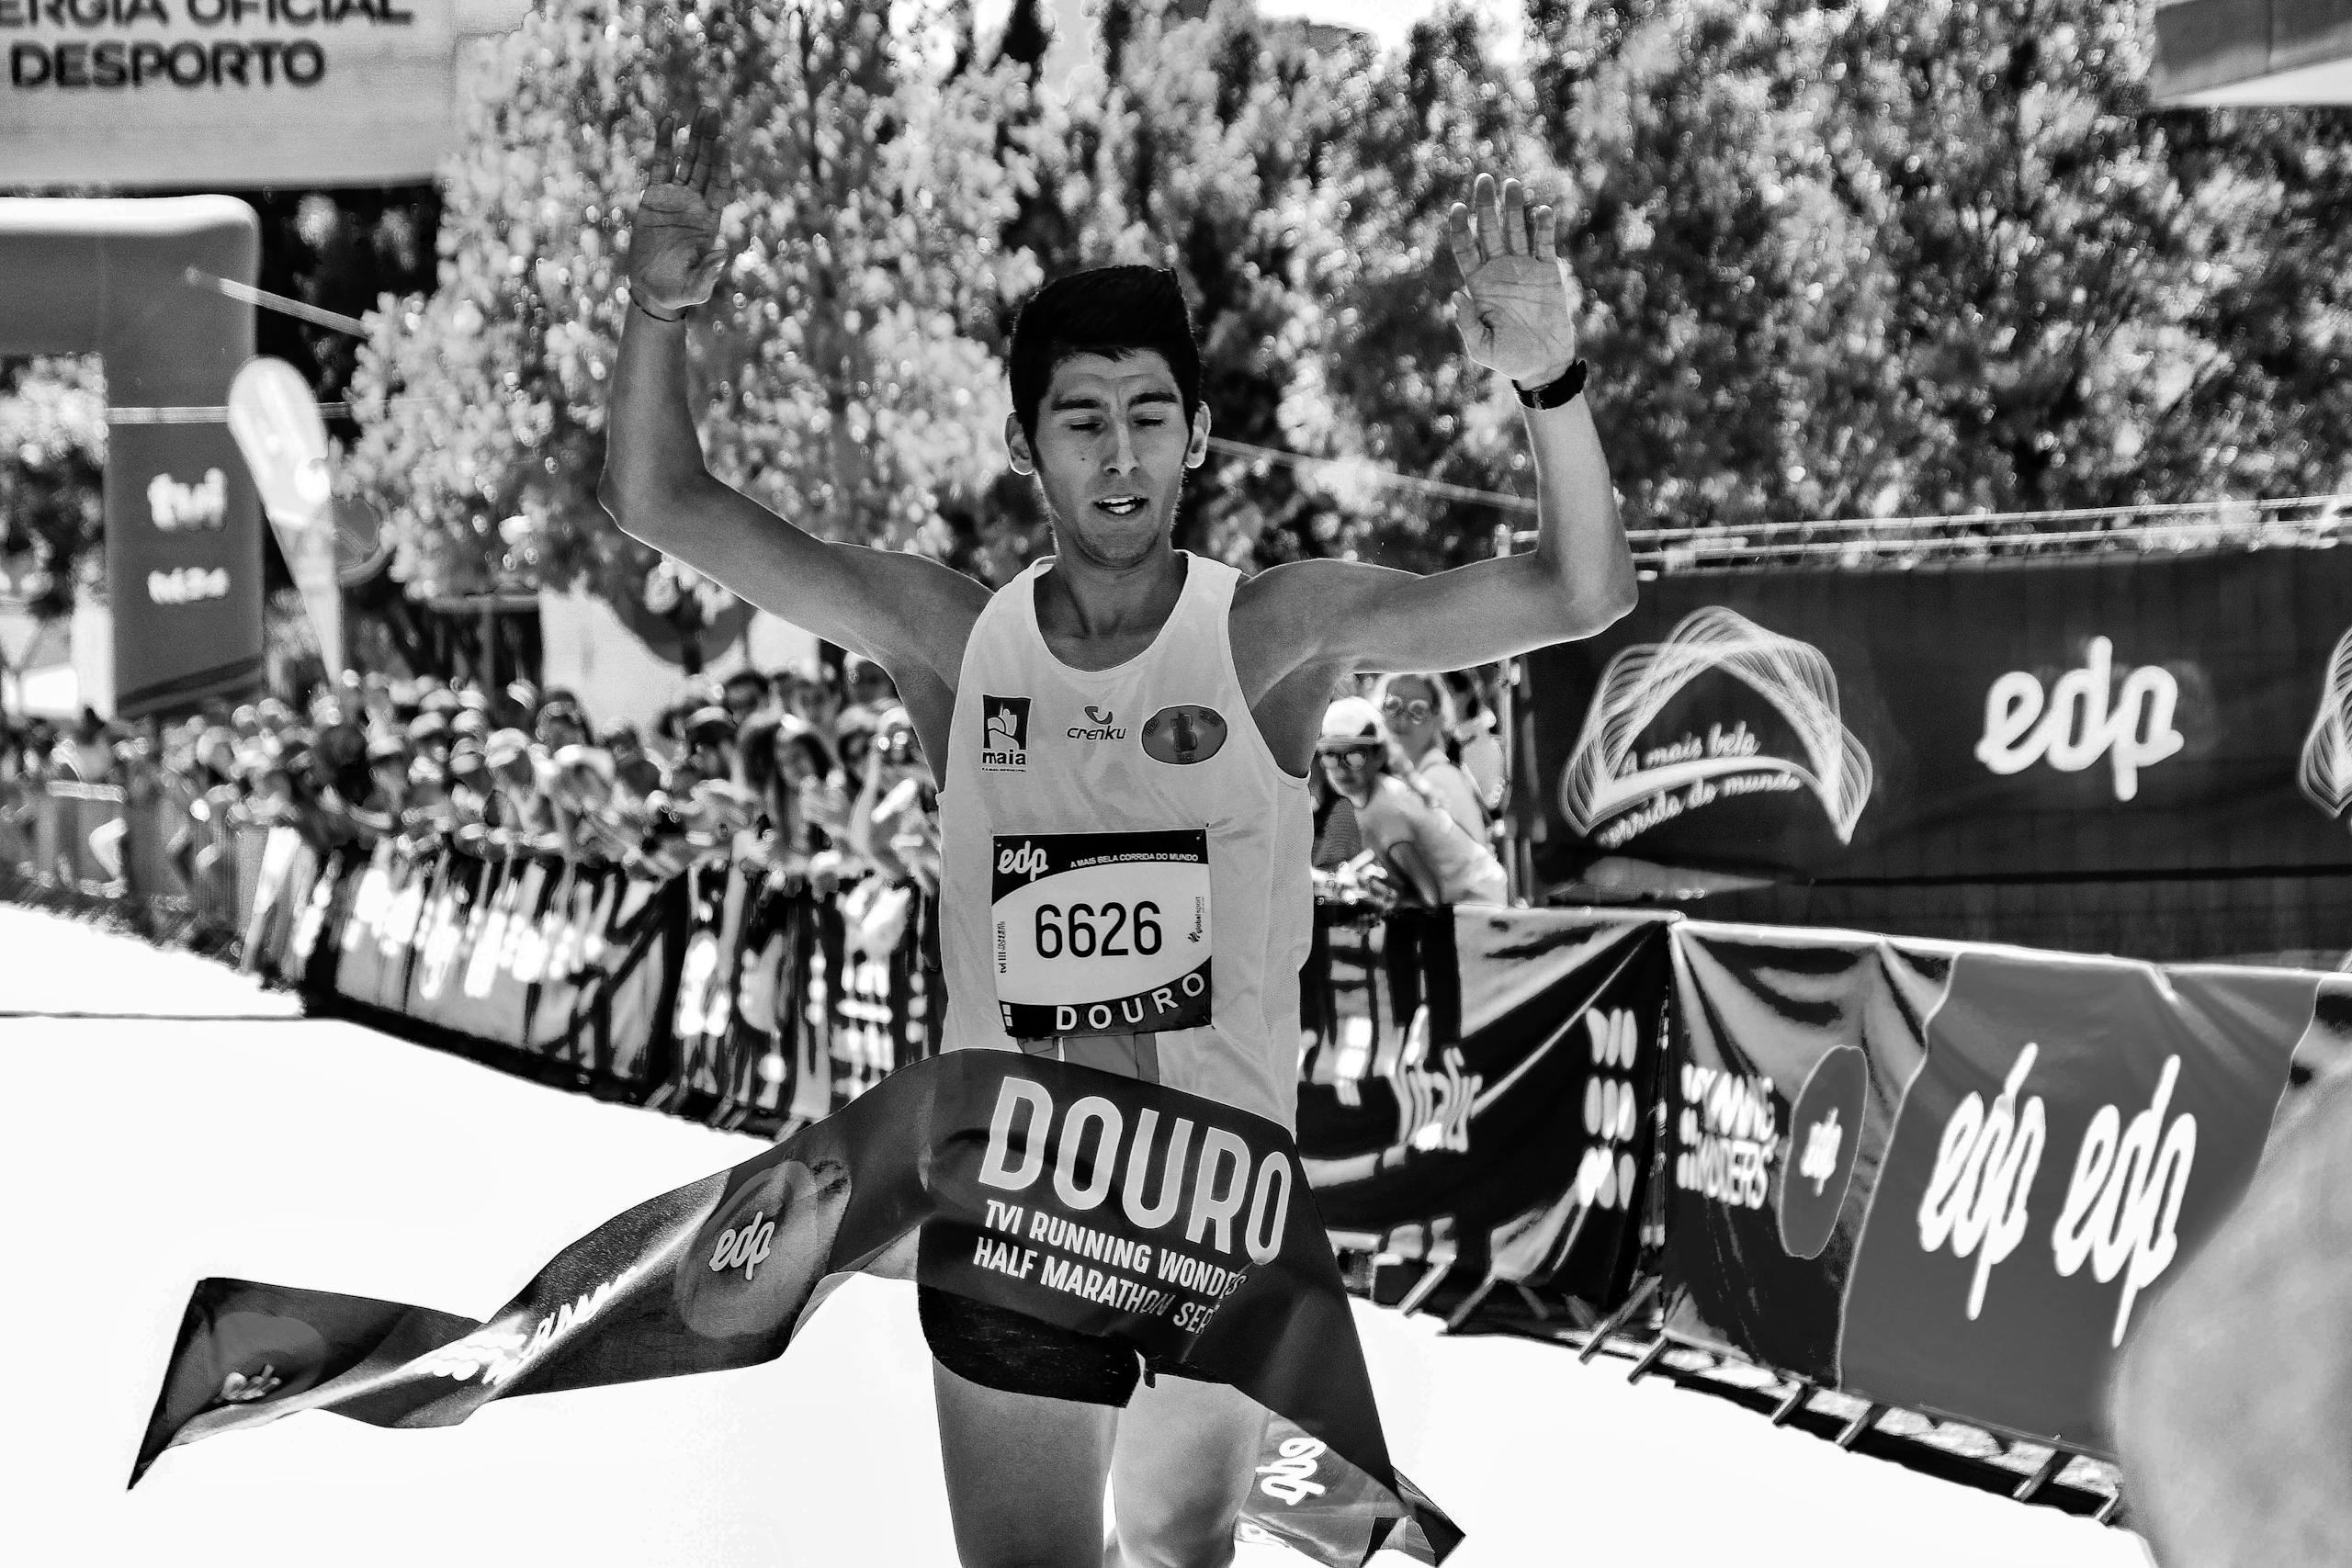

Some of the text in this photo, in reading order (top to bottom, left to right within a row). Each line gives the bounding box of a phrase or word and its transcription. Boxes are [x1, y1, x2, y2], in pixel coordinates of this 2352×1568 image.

[10, 39, 327, 88] DESPORTO
[1067, 725, 1127, 740] crenku
[1643, 731, 1703, 768] mais
[1707, 720, 1762, 757] bela
[1974, 635, 2185, 802] edp
[982, 749, 1027, 765] maia
[1719, 770, 1802, 797] mundo
[997, 840, 1049, 882] edp
[1077, 857, 1097, 867] MAIS
[1097, 854, 1119, 863] BELA
[1119, 853, 1155, 862] CORRIDA
[1156, 852, 1169, 861] DO
[1169, 853, 1199, 862] MUNDO
[1035, 900, 1162, 959] 6626
[1057, 973, 1204, 1031] DOURO
[978, 1076, 1292, 1267] DOURO
[1919, 1043, 2046, 1321] edp
[2052, 1055, 2197, 1348] edp
[708, 1211, 775, 1281] edp
[985, 1199, 1023, 1235] TVI
[1029, 1211, 1152, 1274] RUNNING
[972, 1236, 1038, 1280] HALF
[1040, 1255, 1176, 1316] MARATHON
